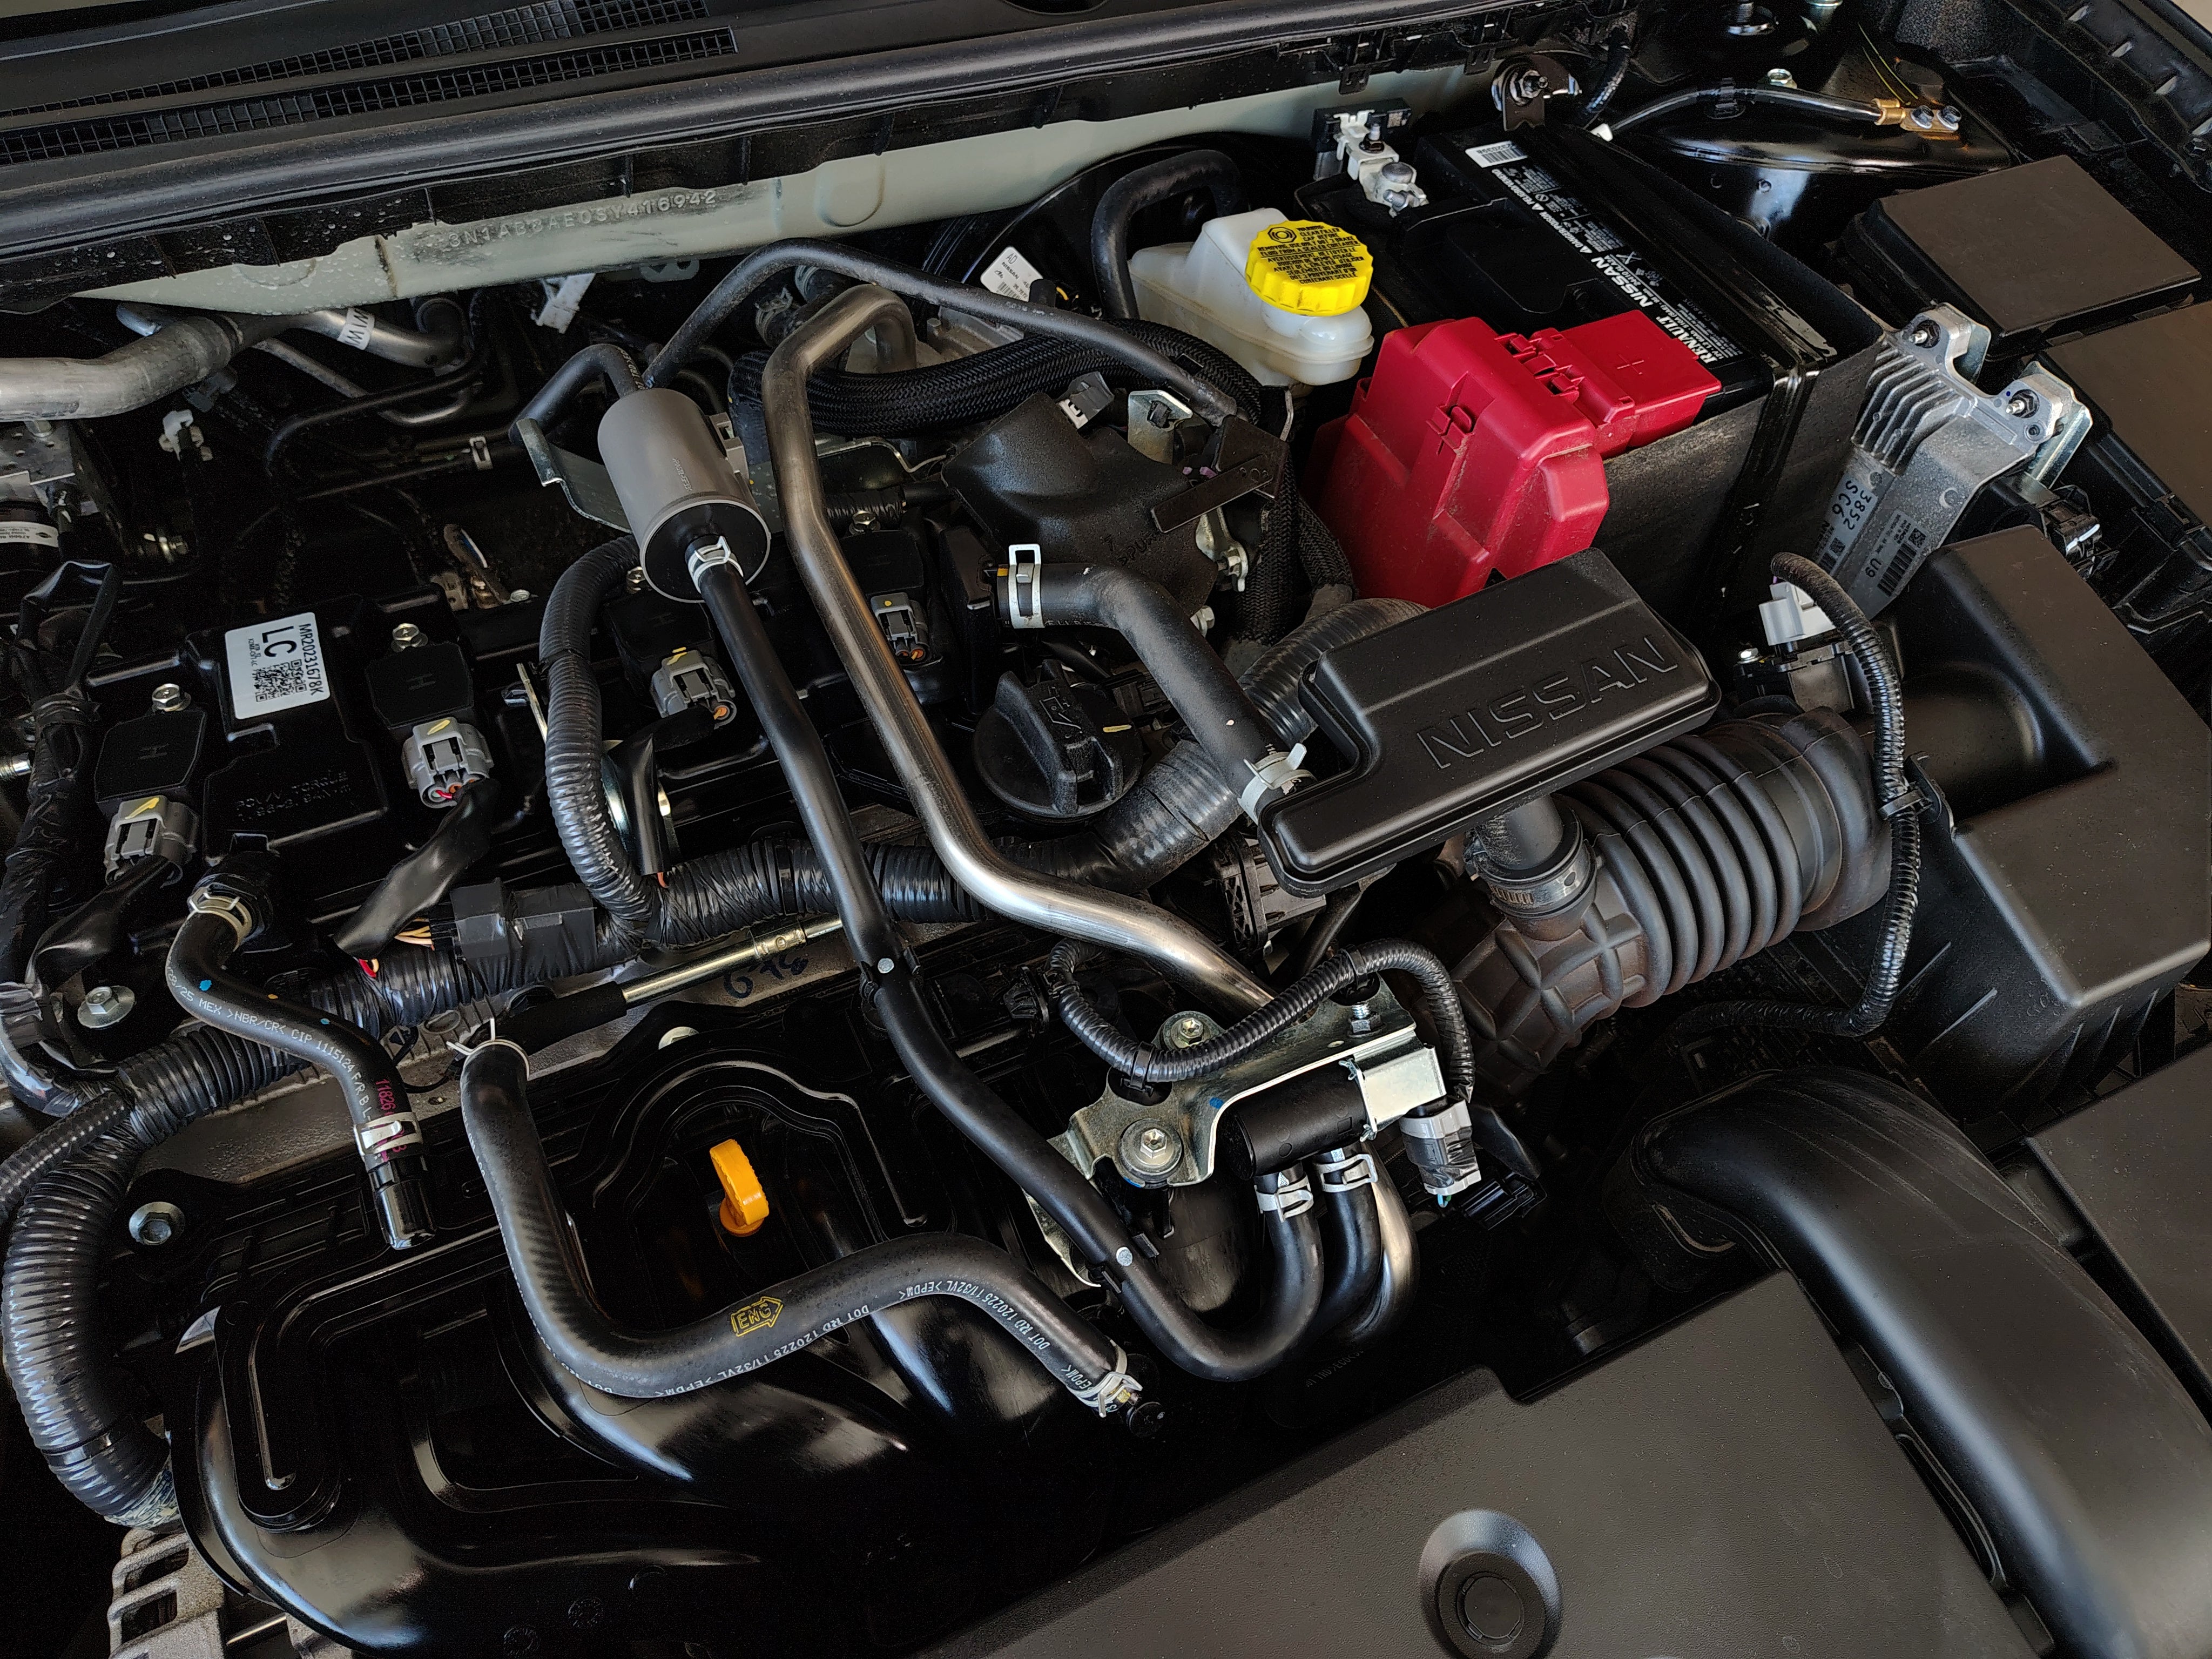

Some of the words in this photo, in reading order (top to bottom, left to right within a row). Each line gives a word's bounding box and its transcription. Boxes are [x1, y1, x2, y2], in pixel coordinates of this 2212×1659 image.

[1001, 261, 1019, 279] NISSAN
[1005, 252, 1018, 265] AD
[1314, 253, 1353, 261] REMPLISSAGE
[1287, 267, 1321, 275] SEULEMENT
[1299, 276, 1334, 284] CONTENANT
[1309, 270, 1342, 278] PROVENANT
[1590, 255, 1654, 308] NISSAN
[1655, 315, 1717, 363] RENAULT
[1832, 481, 1858, 518] SC6
[1843, 493, 1871, 530] 3852
[1865, 558, 1881, 577] U9
[261, 624, 298, 655] LC
[298, 622, 324, 695] MR20231678K
[1416, 635, 1678, 770] NISSAN
[199, 997, 222, 1016] MEX
[291, 1029, 312, 1044] CIP
[358, 1096, 368, 1105] B
[375, 1079, 396, 1111] 11826
[899, 1280, 942, 1298] >EPDM<
[945, 1280, 984, 1298] 11/32VL
[739, 1303, 771, 1330] ENG
[846, 1304, 869, 1321] DOT
[981, 1291, 1018, 1321] 120225
[773, 1329, 818, 1358] 120225
[1027, 1332, 1050, 1351] DOT
[717, 1353, 770, 1379] 11/32VL
[655, 1375, 713, 1397] >EPDM<
